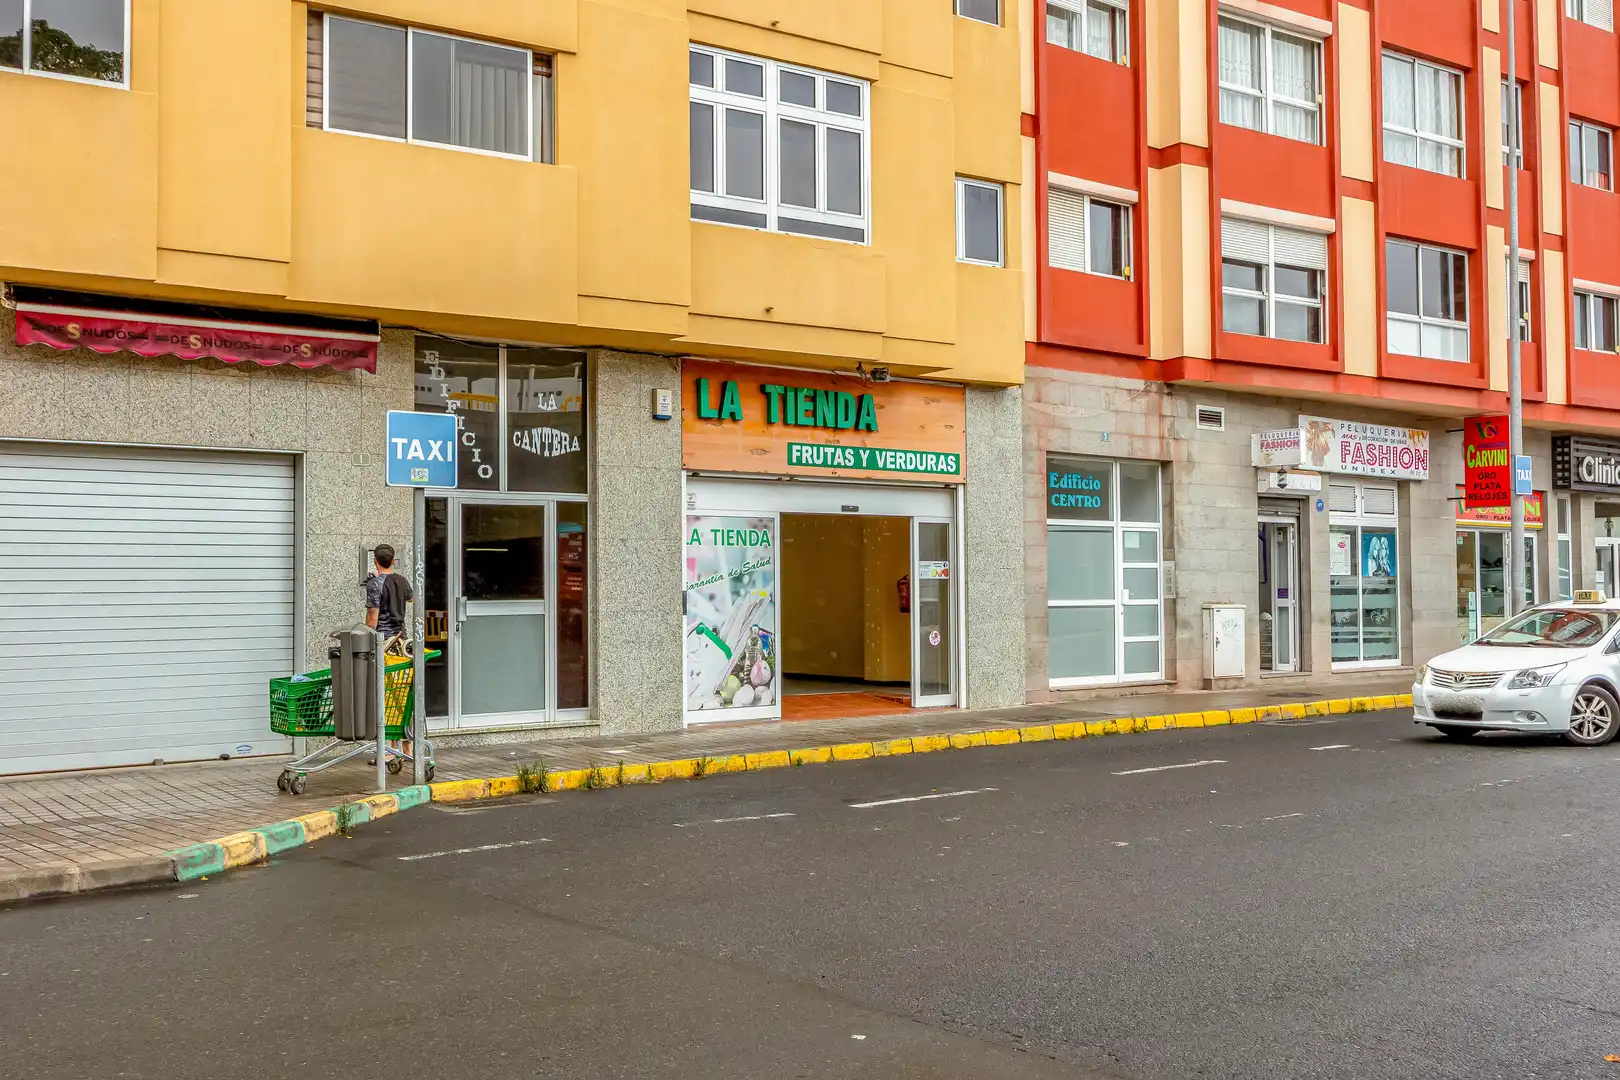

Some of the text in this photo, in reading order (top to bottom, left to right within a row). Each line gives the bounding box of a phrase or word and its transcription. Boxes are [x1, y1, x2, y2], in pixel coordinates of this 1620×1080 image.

[46, 322, 134, 342] DESNUDOS
[170, 333, 250, 351] DESNUDOS
[538, 393, 558, 411] LA
[695, 378, 879, 433] LA TIENDA
[1340, 423, 1407, 438] PELUQUERIA
[391, 437, 453, 462] TAXI
[513, 427, 580, 457] CANTERA
[1260, 439, 1300, 450] FASHION
[791, 444, 957, 473] FRUTAS Y VERDURAS
[1340, 440, 1428, 471] FASHION
[1341, 464, 1396, 475] UNISEX
[1477, 471, 1497, 480] ORO
[1516, 468, 1531, 481] TAXI
[1049, 471, 1101, 491] Edificio
[1473, 482, 1501, 491] PLATA
[1051, 493, 1101, 508] CENTRO
[1468, 491, 1508, 501] RELOJES
[686, 528, 771, 547] A TIENDA
[686, 556, 771, 591] arantia de Salud
